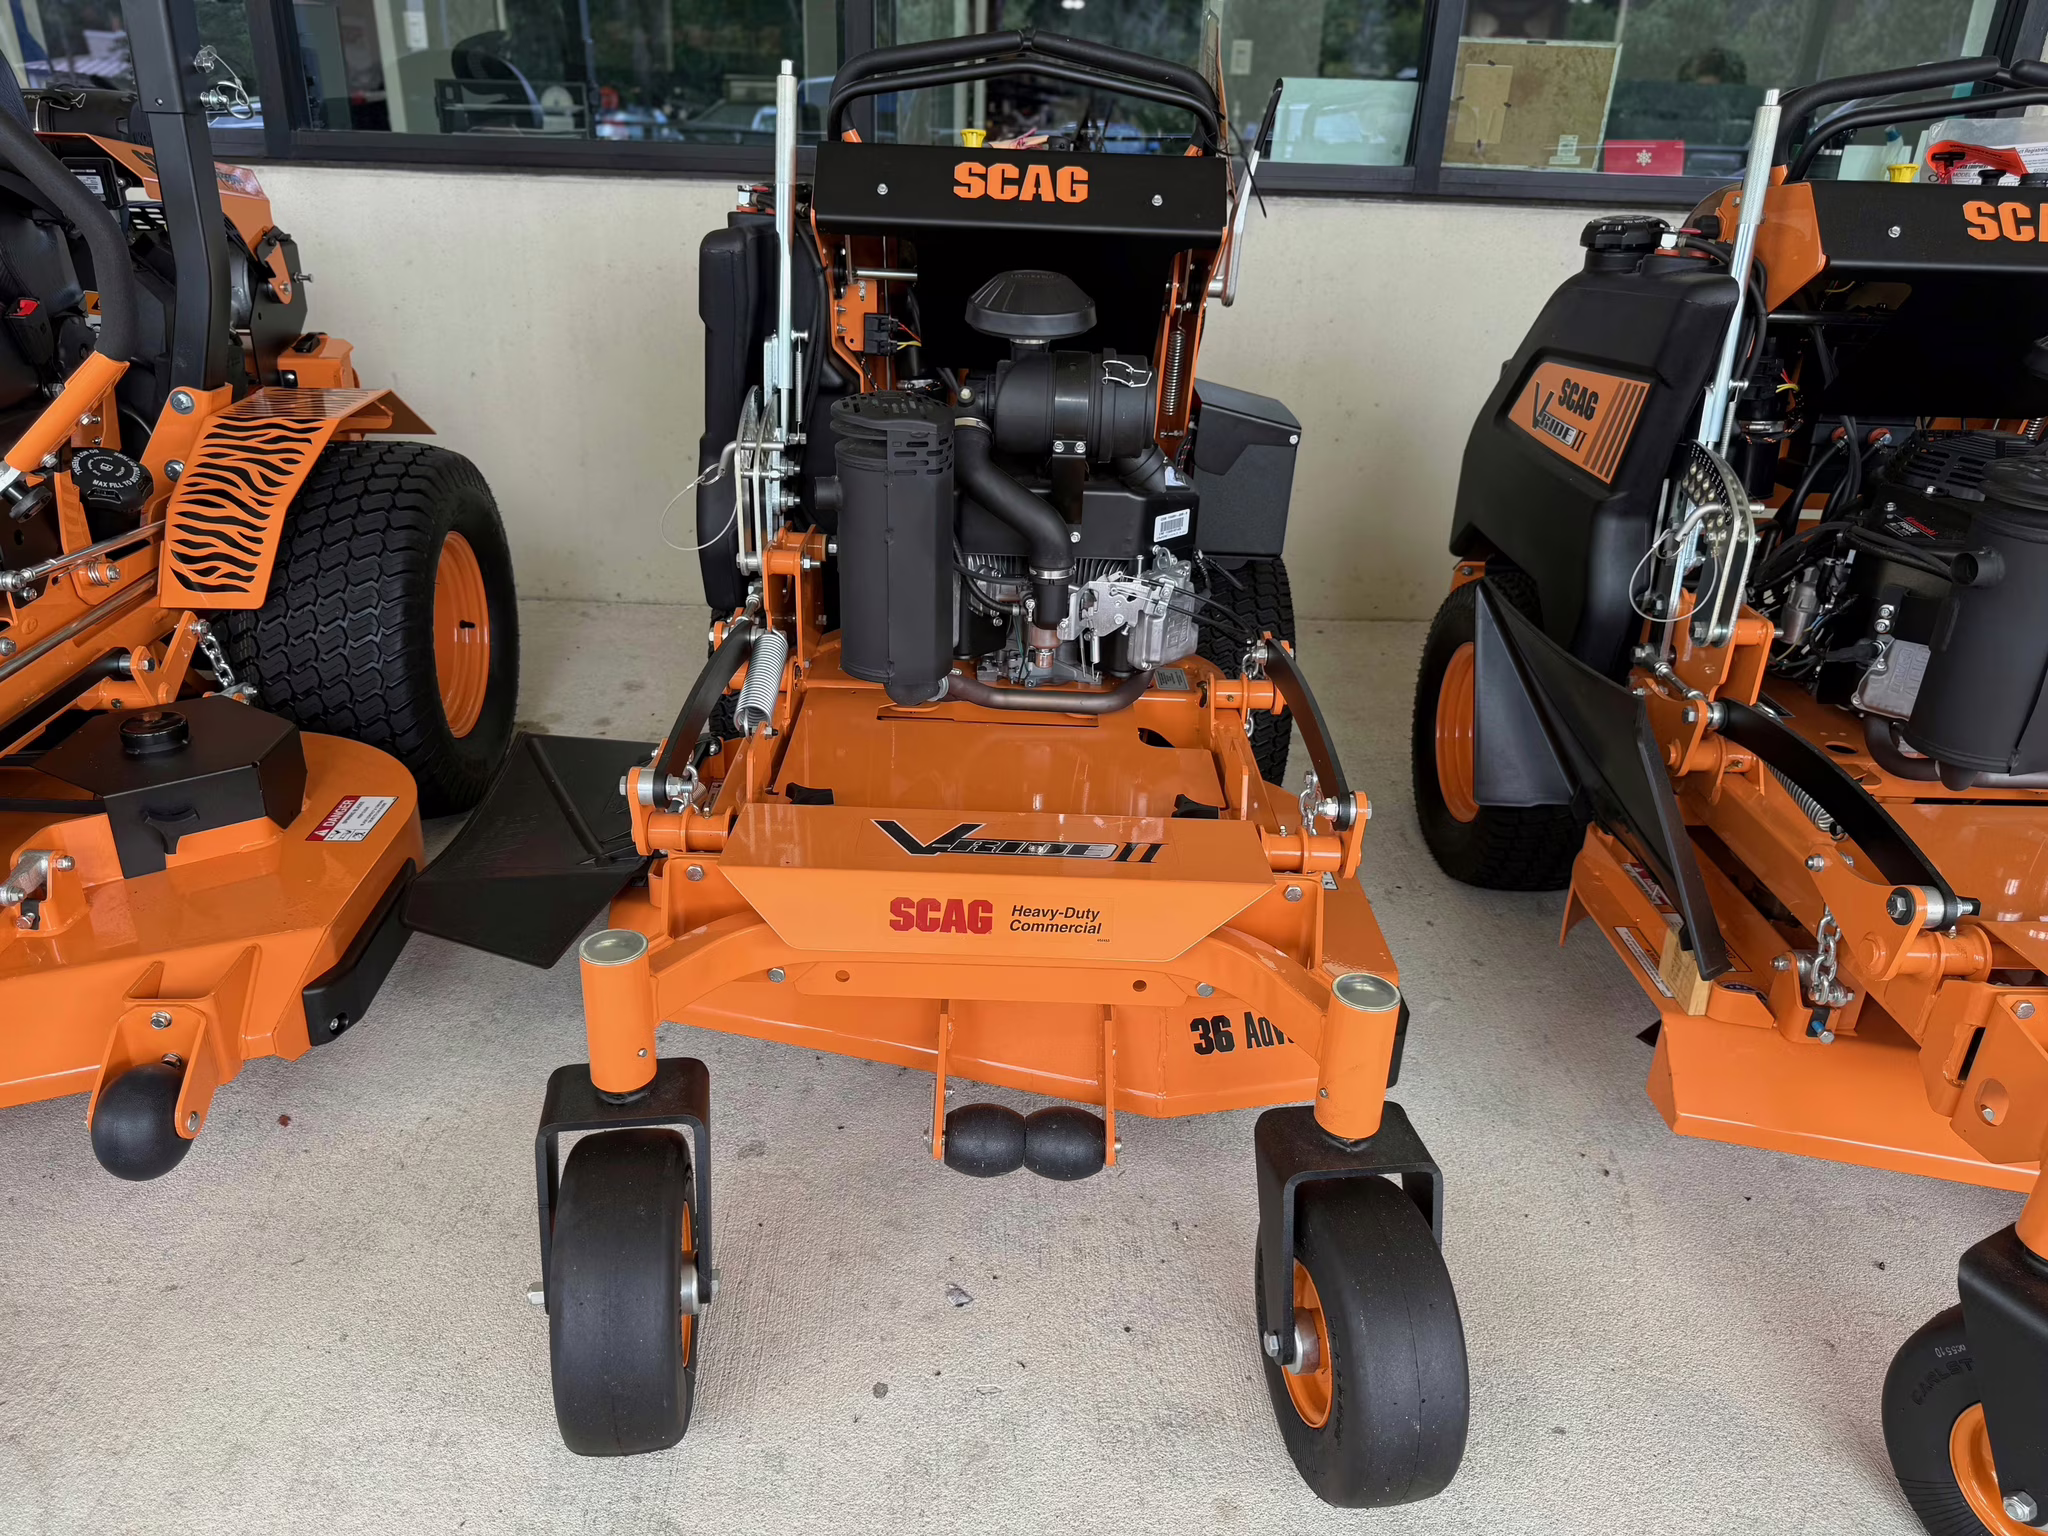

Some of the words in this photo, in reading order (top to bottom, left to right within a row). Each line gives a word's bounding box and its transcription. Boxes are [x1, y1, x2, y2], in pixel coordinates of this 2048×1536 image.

[953, 161, 1090, 204] SCAG
[1962, 200, 2048, 242] SC
[1558, 378, 1600, 422] SCAG
[322, 799, 357, 827] DANGER
[889, 896, 994, 935] SCAG
[1009, 919, 1103, 935] Commercial
[1011, 904, 1101, 923] Heavy-Duty
[1189, 1014, 1236, 1056] 36
